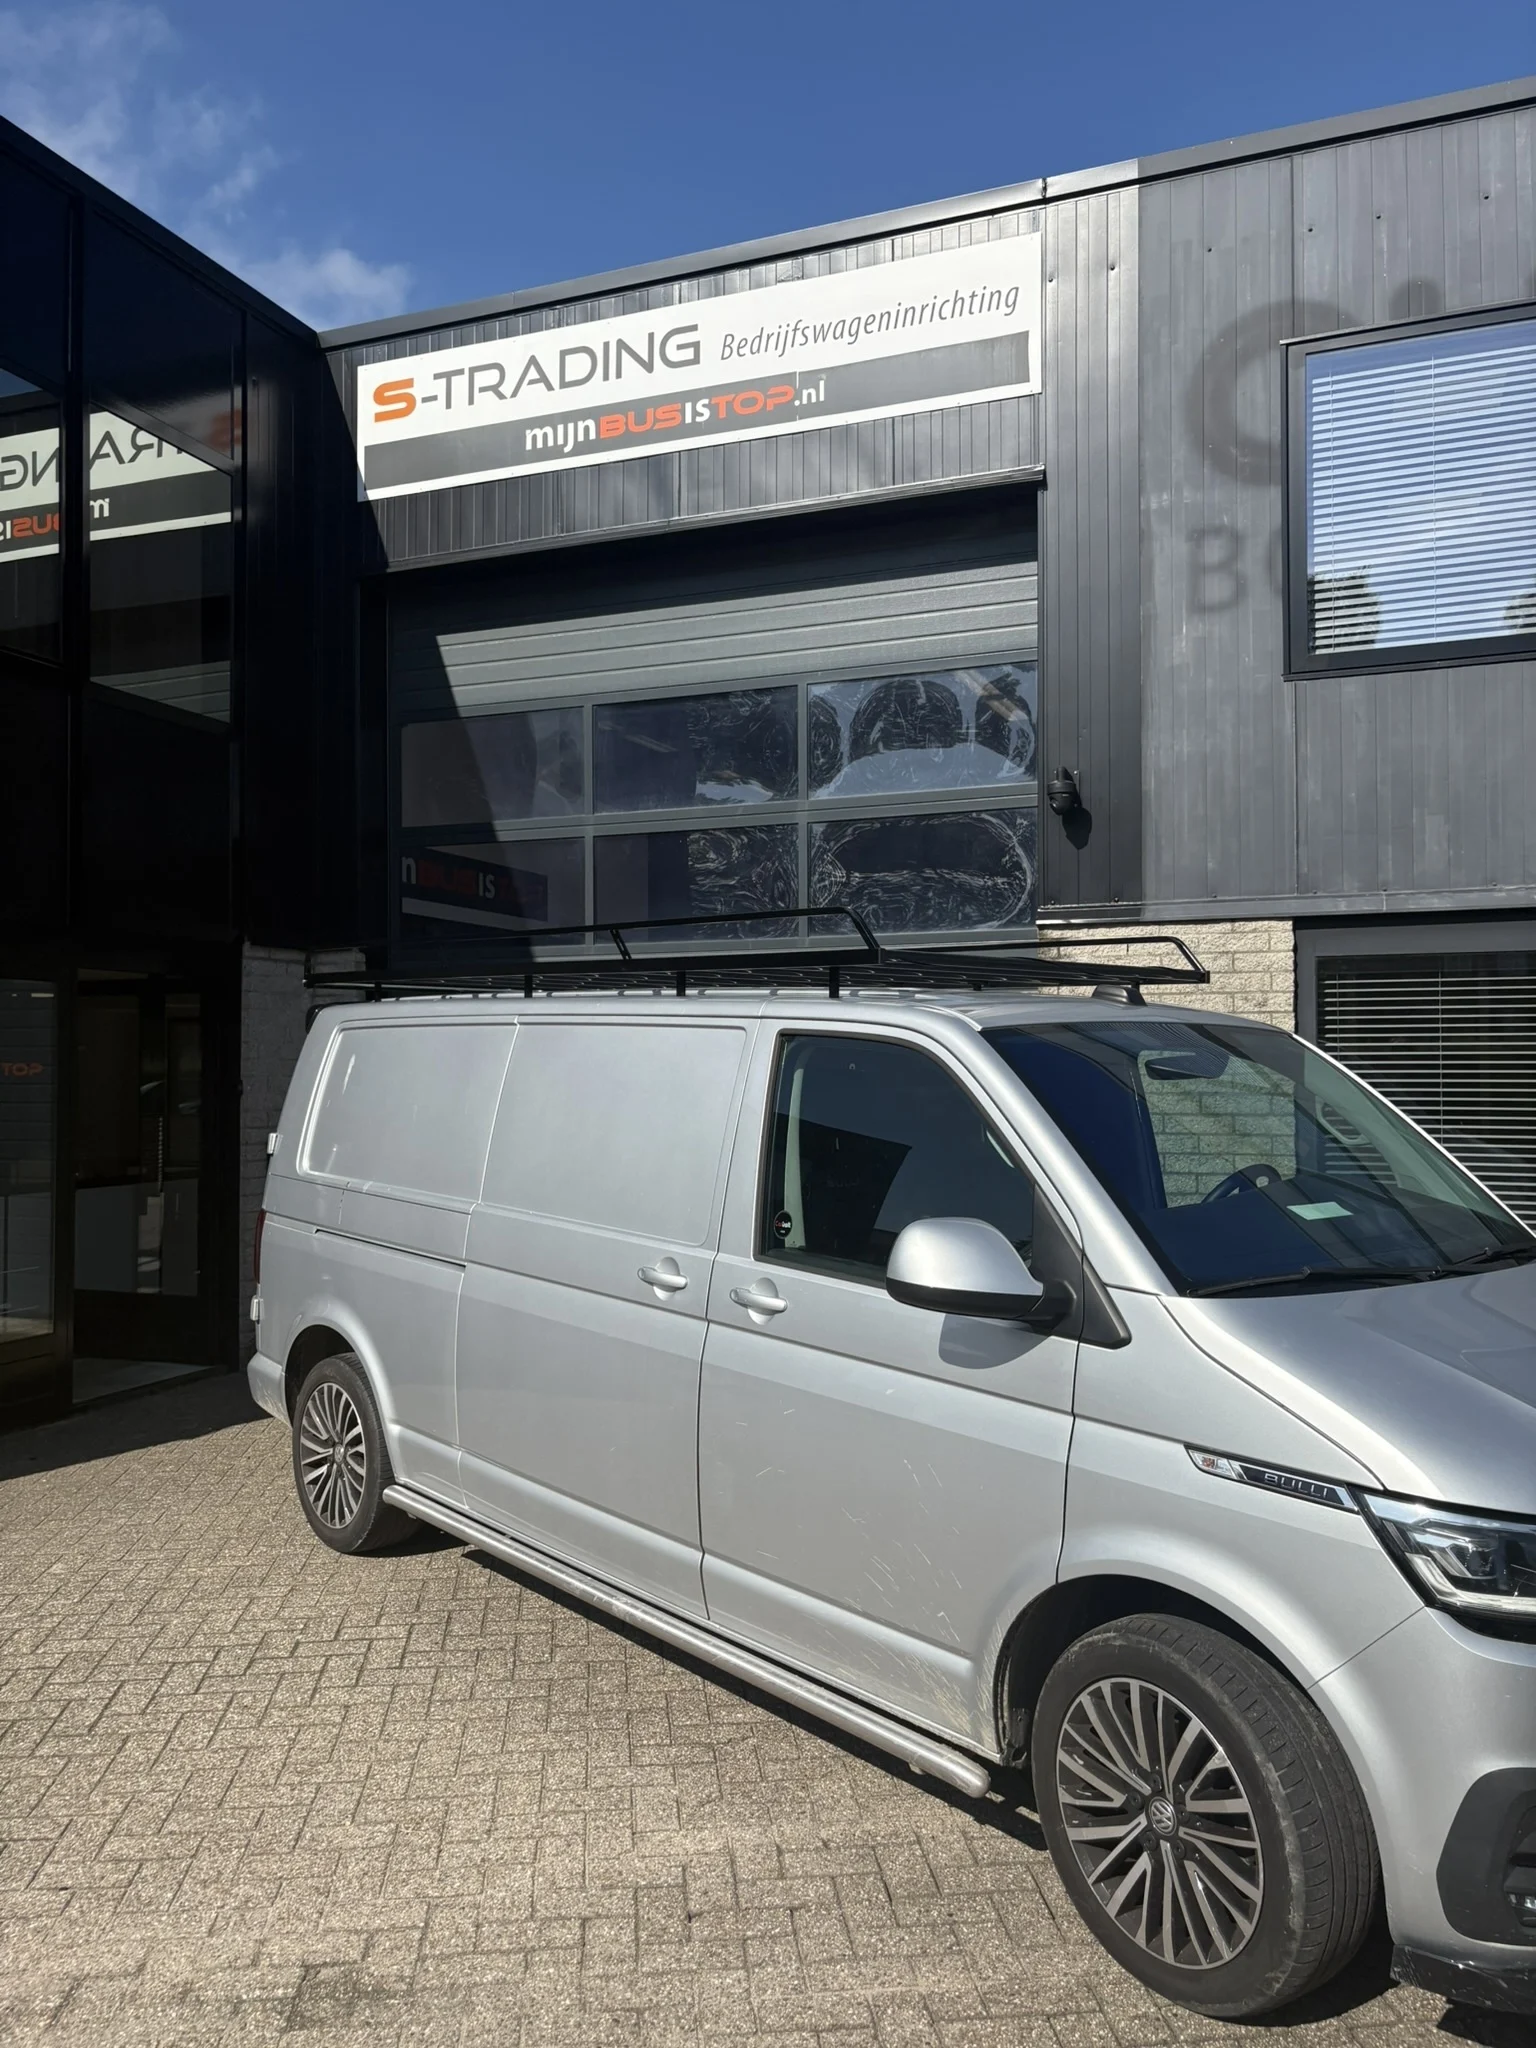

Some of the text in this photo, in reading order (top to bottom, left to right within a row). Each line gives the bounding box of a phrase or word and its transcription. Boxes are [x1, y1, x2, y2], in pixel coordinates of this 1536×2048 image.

[373, 285, 1020, 423] S-TRADING Bedrijfswageninrichting
[1264, 1473, 1328, 1498] BULLI
